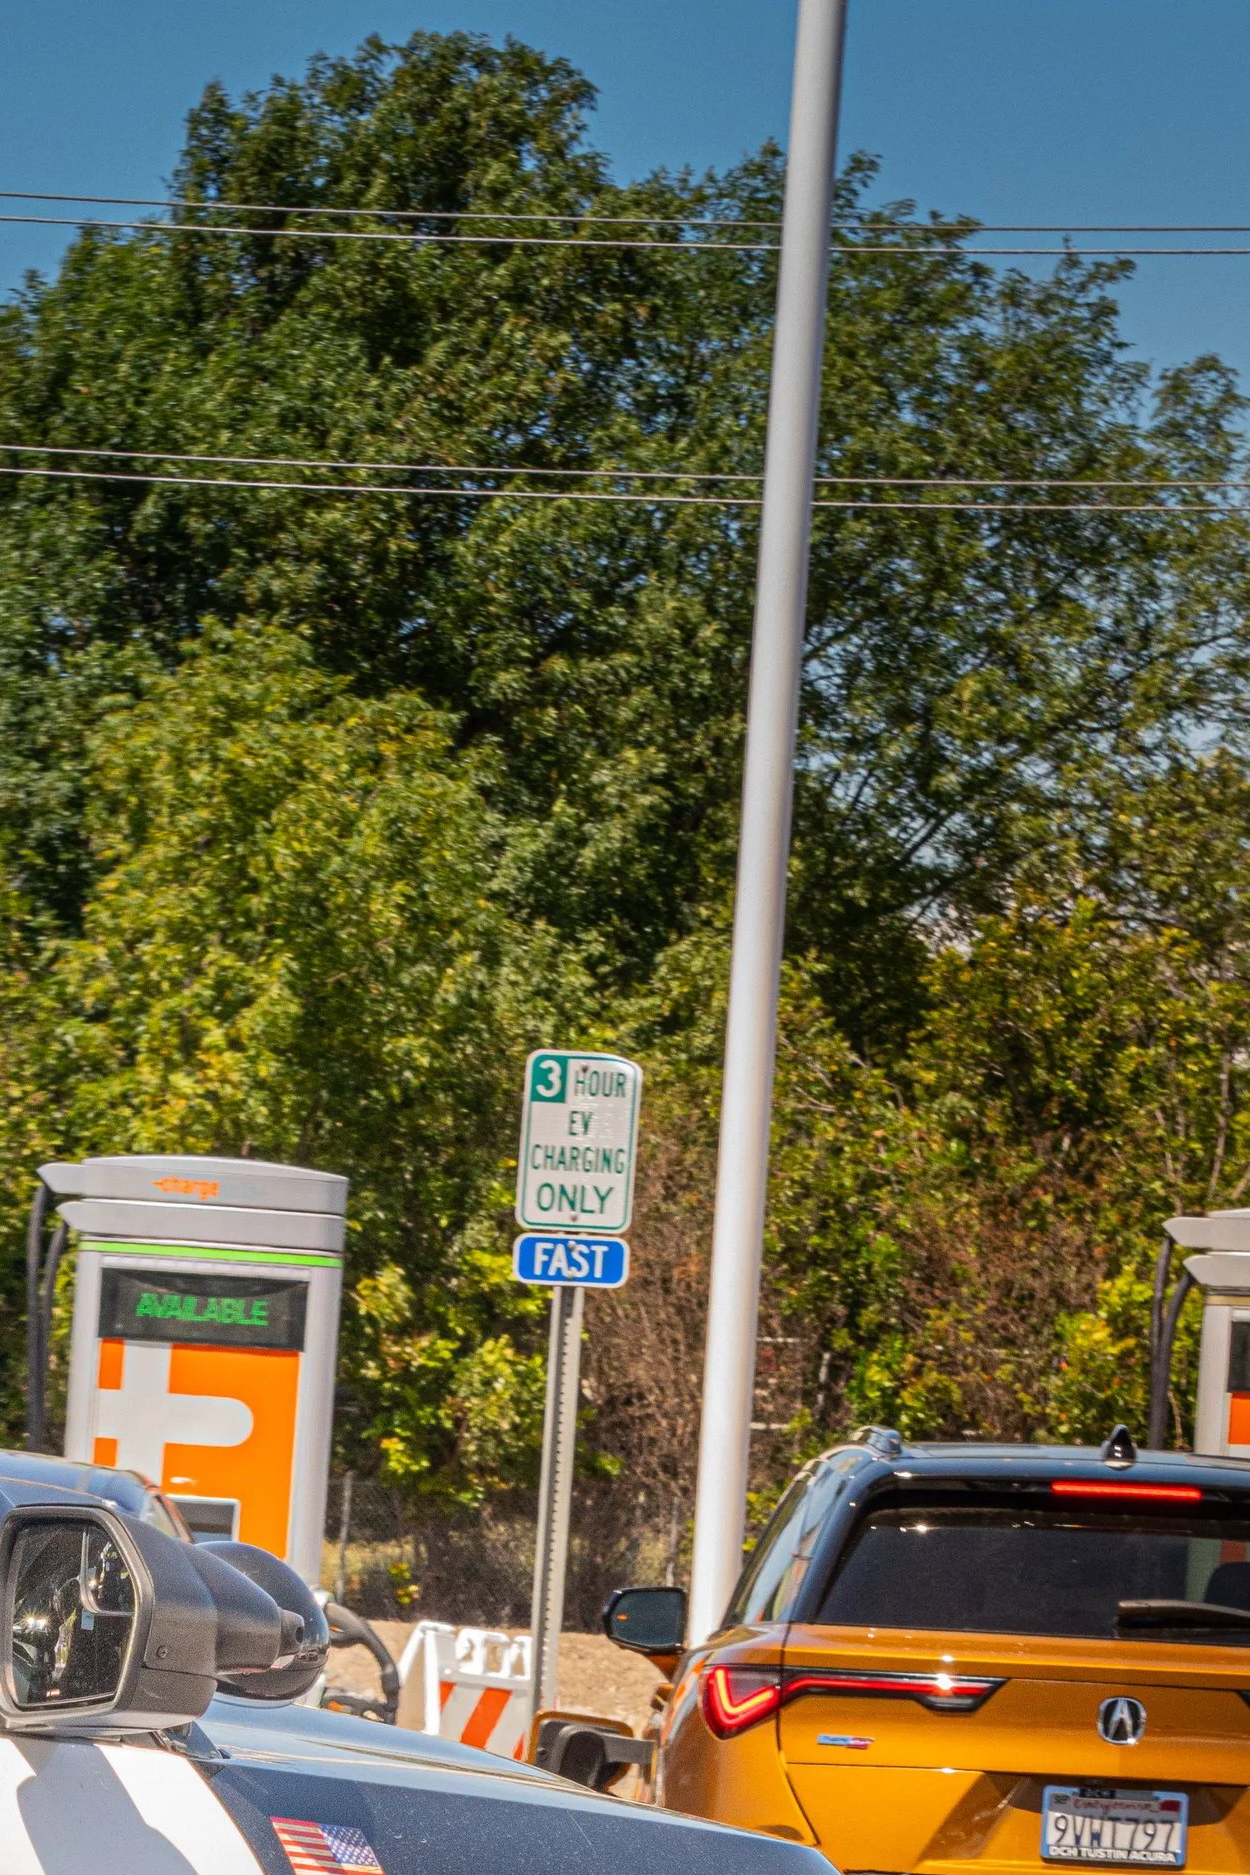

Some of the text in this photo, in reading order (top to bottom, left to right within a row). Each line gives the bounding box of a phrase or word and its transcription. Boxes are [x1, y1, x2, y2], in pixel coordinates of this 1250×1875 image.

[536, 1059, 627, 1098] 3 HOUR
[568, 1110, 593, 1136] EV
[531, 1143, 625, 1174] CHARGING
[536, 1183, 614, 1215] ONLY
[533, 1241, 610, 1279] FAST
[136, 1292, 269, 1326] AVAILABLE
[1049, 1846, 1176, 1863] DCH TUSTIN ACURA
